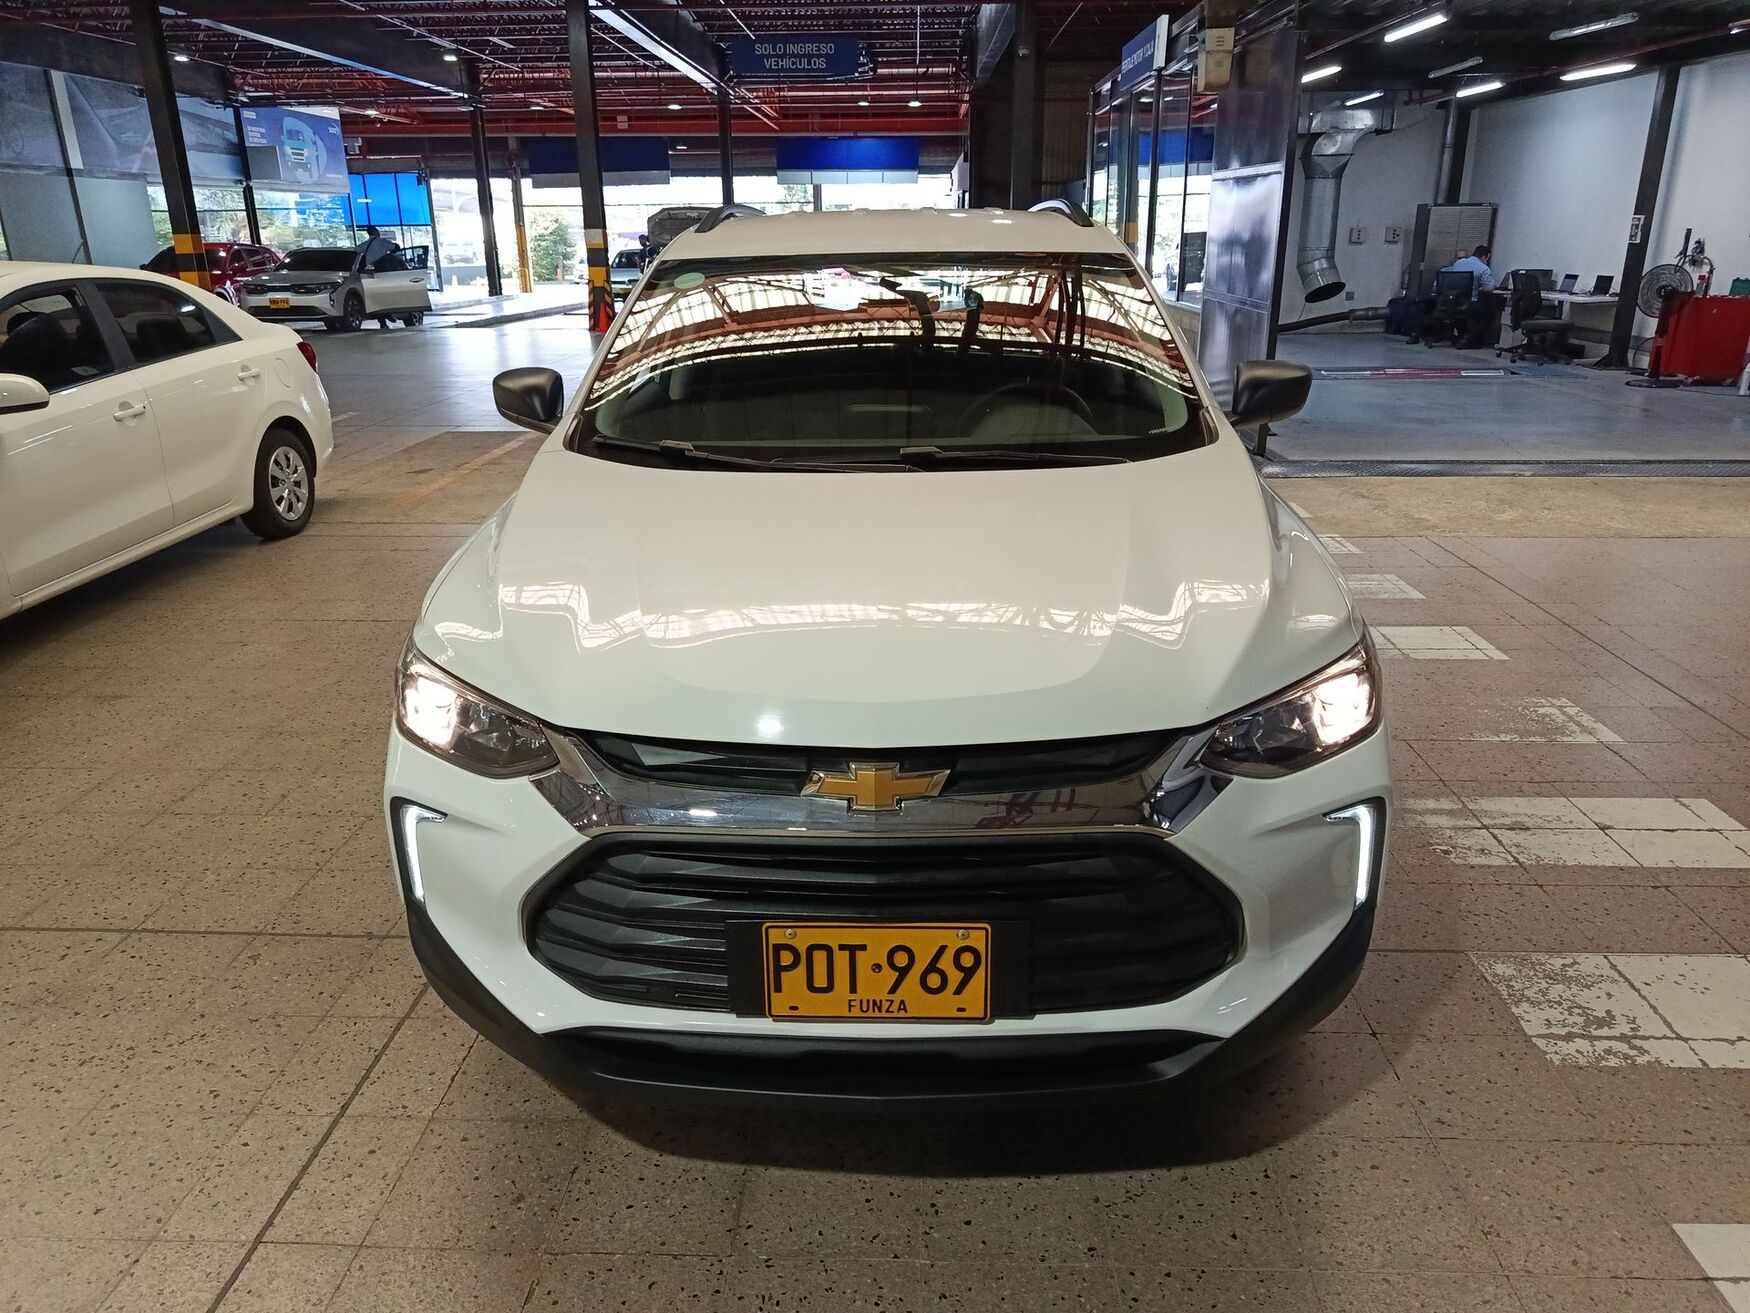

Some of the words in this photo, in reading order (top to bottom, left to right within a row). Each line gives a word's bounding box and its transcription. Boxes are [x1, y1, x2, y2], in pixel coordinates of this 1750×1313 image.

[754, 43, 784, 55] SOLO
[786, 43, 835, 55] INGRESO
[764, 56, 827, 69] VEHÍCULOS
[847, 998, 908, 1014] FUNZA
